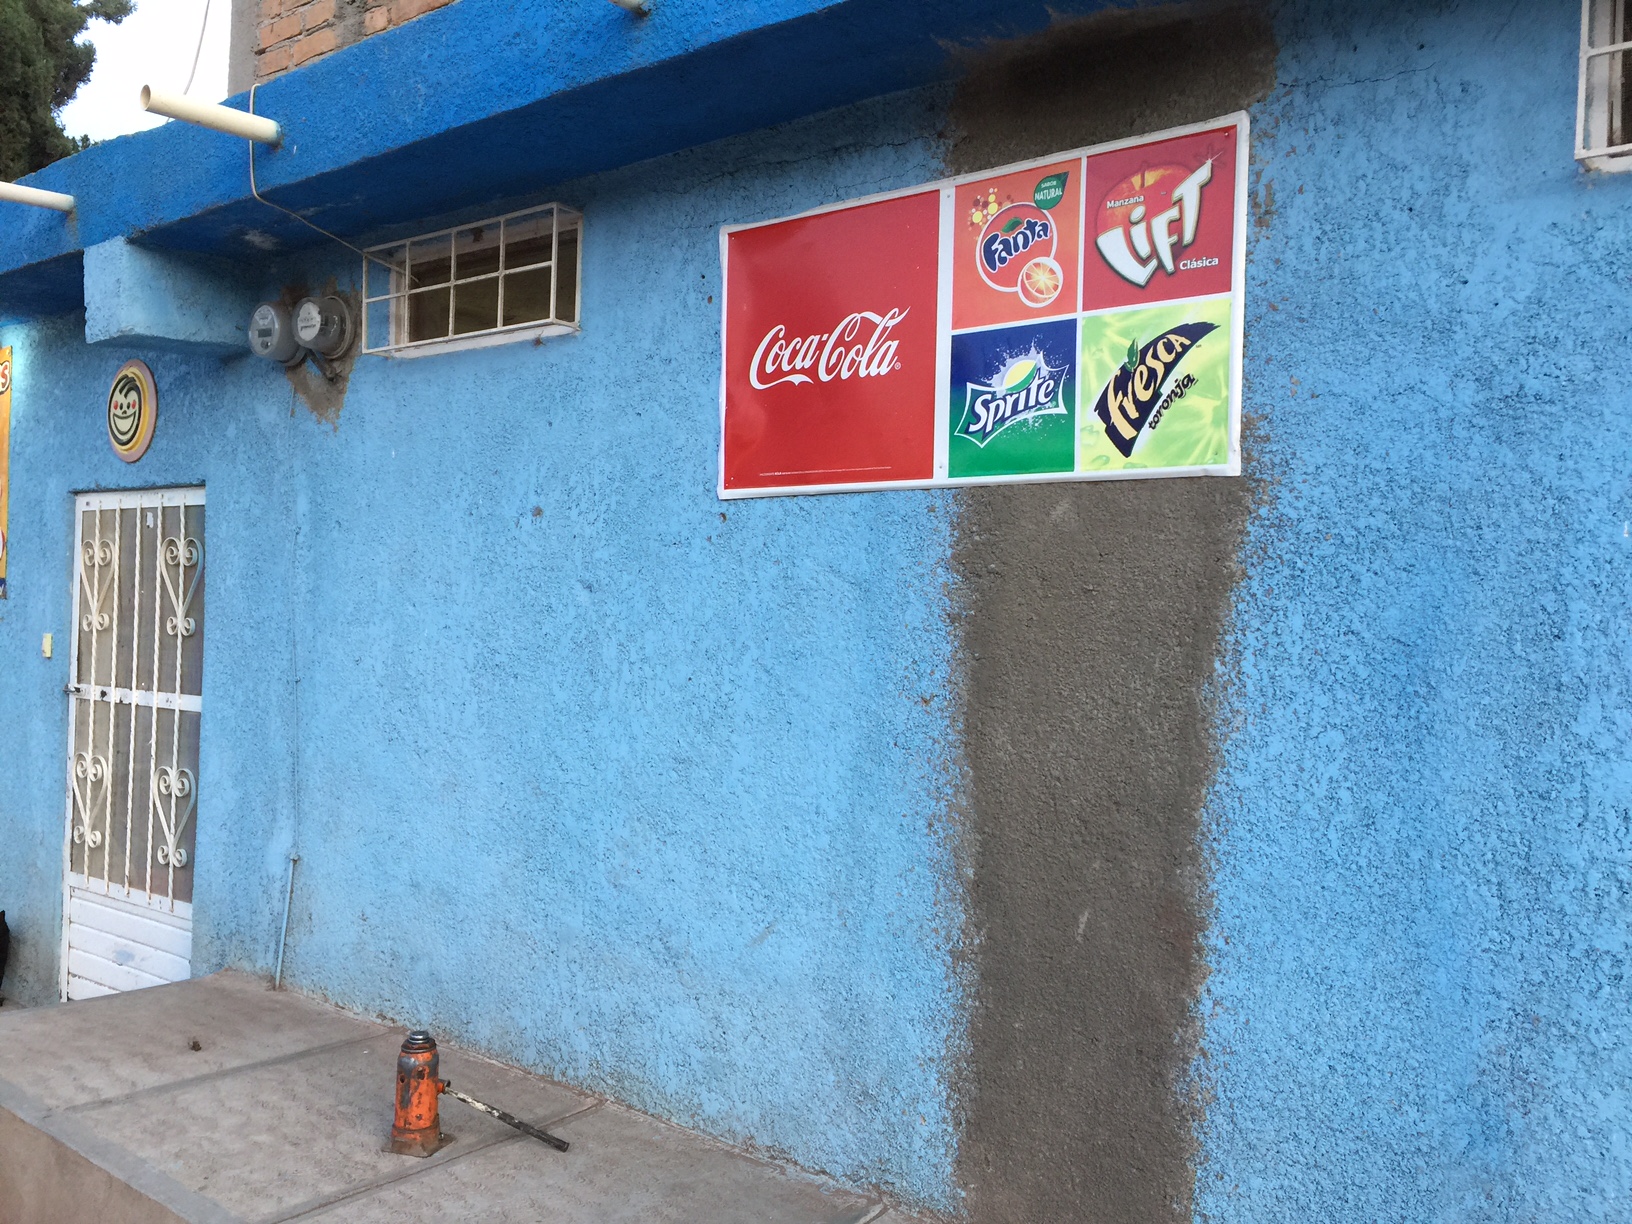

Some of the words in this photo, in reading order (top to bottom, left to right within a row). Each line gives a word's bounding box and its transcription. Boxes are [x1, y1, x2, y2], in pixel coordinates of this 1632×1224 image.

[1034, 187, 1063, 201] NATURAL
[1106, 195, 1145, 209] Manzana
[982, 218, 1051, 273] Fanta
[1179, 256, 1219, 270] Clásica
[749, 306, 911, 390] Coca-Cola
[967, 370, 1055, 434] Sprite
[1148, 373, 1198, 430] toronja
